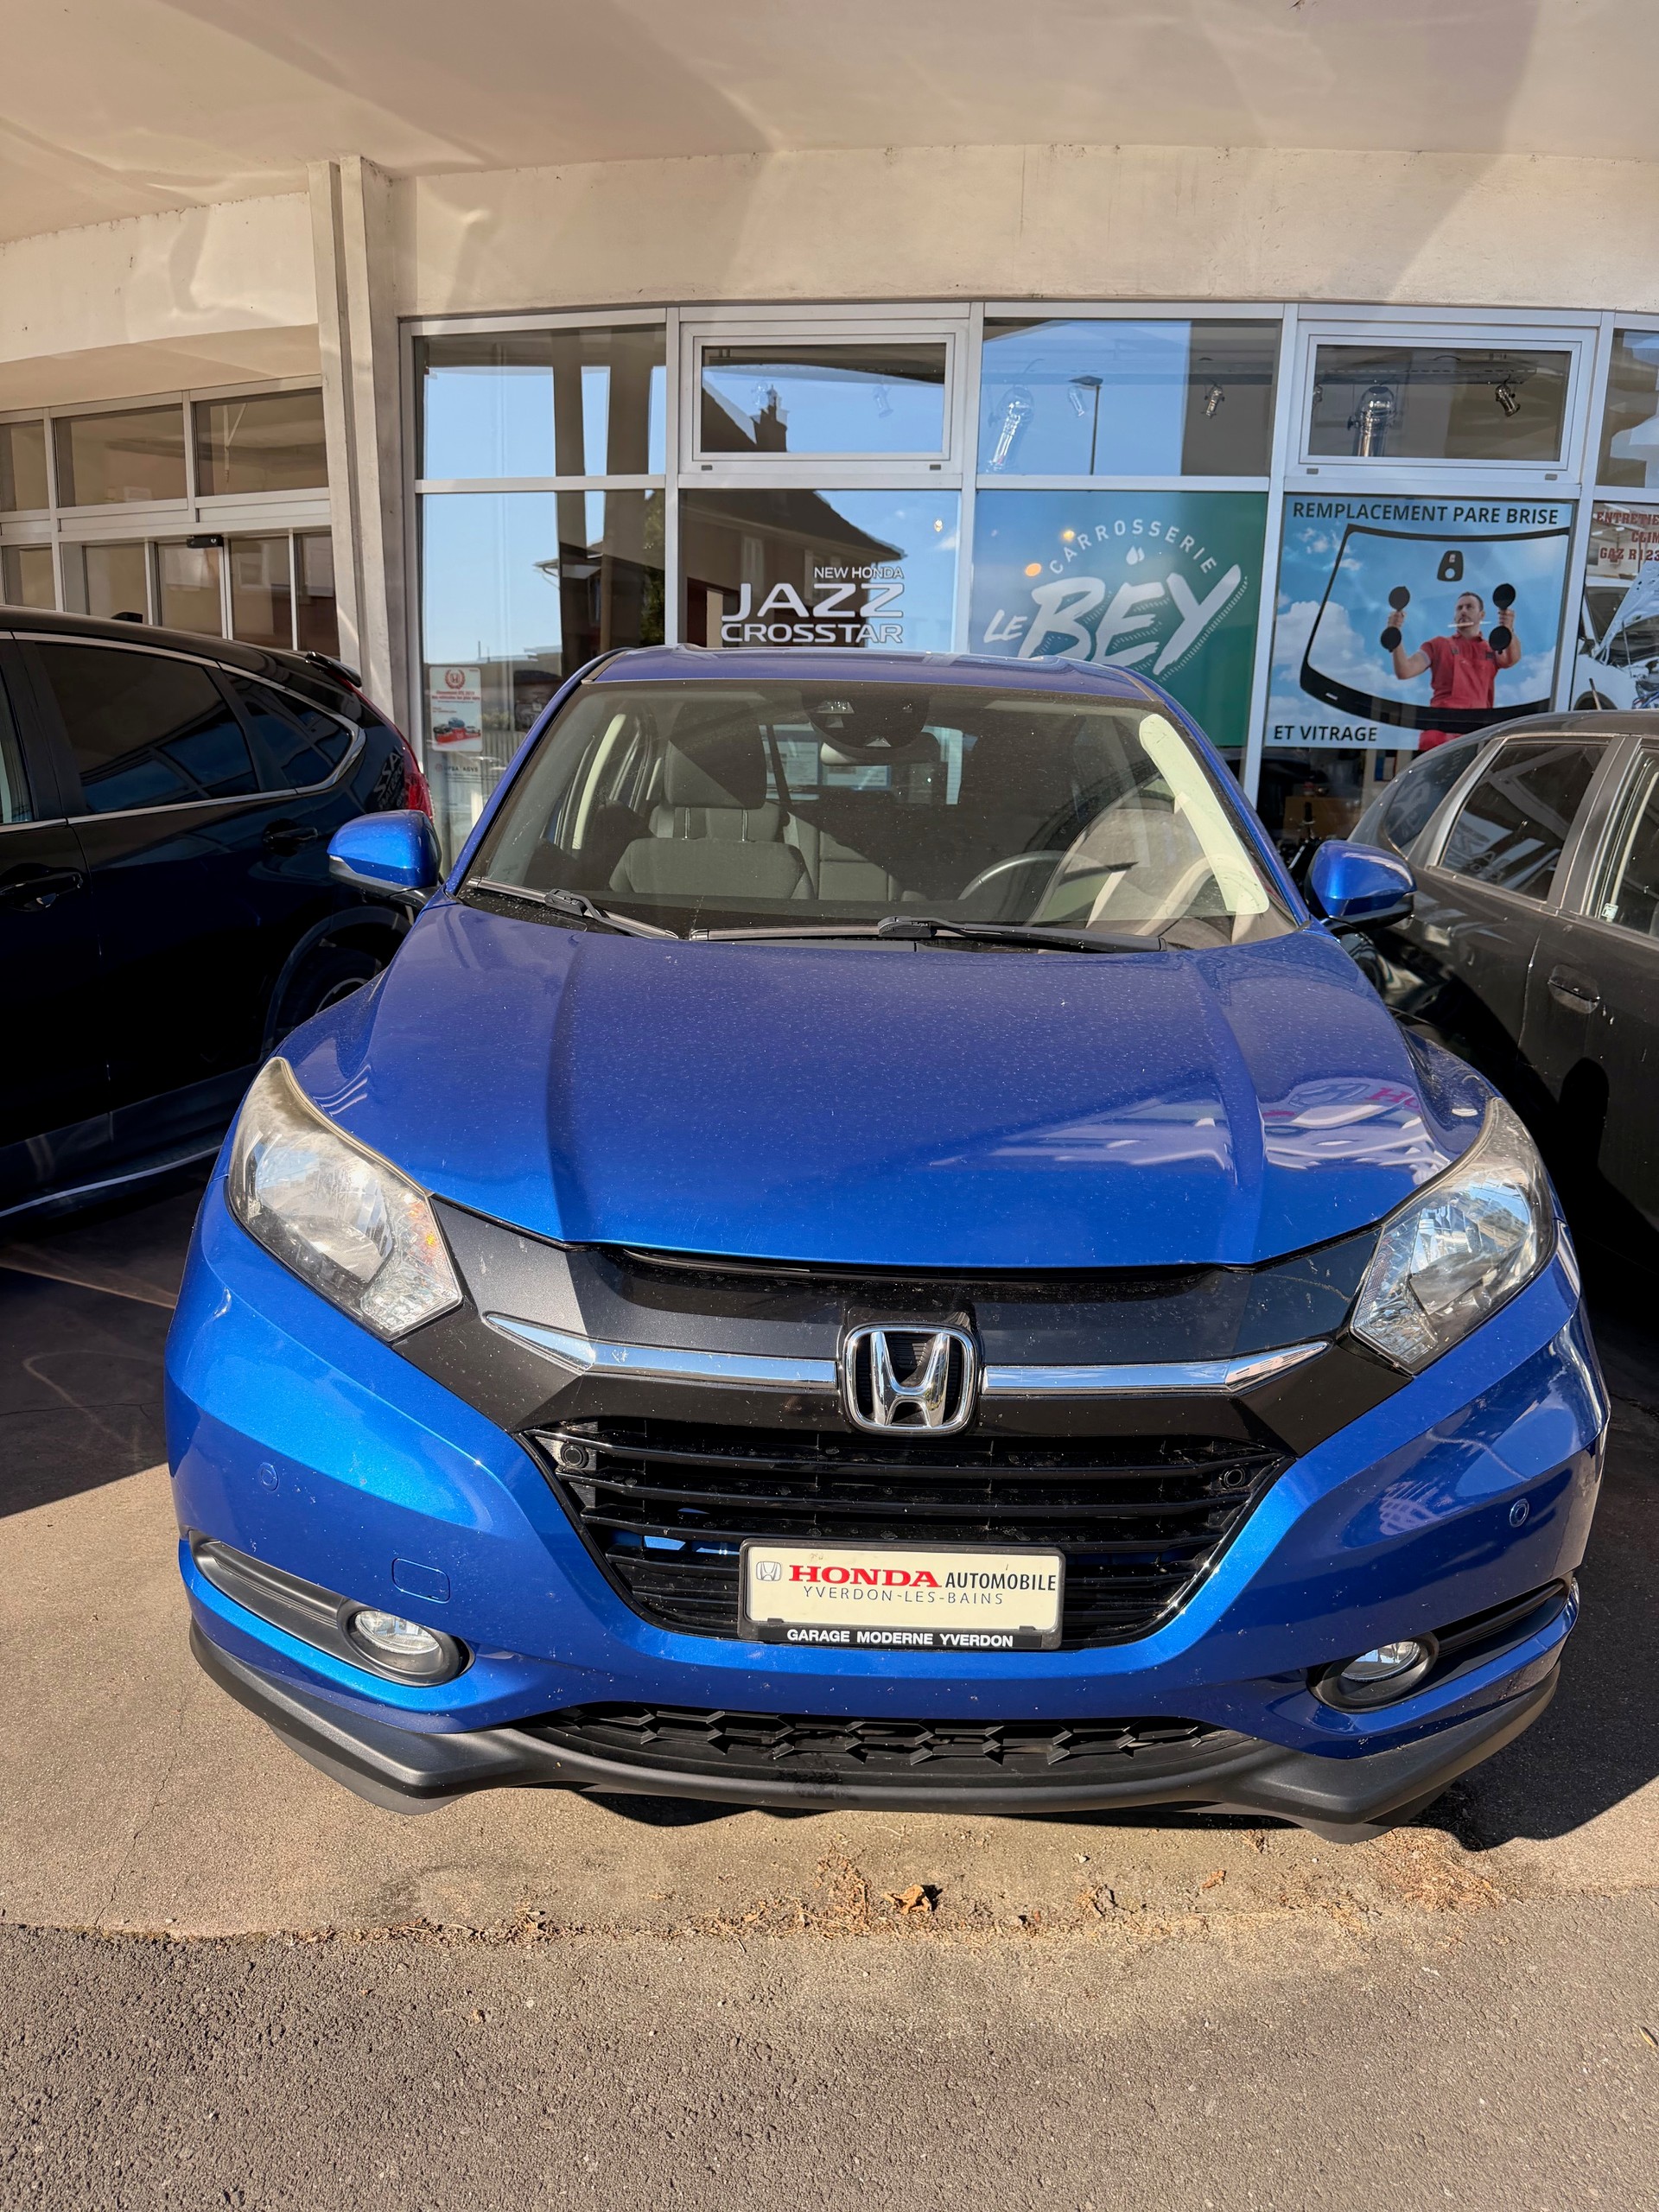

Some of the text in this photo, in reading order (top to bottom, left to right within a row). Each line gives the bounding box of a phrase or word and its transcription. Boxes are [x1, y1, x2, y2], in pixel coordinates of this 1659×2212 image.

[1293, 502, 1559, 524] REMPLACEMENT PARE BRISE
[1049, 518, 1217, 574] CARROSSERIE
[1599, 547, 1624, 560] GAZ
[813, 567, 905, 579] NEW HONDA
[721, 582, 905, 622] JAZZ
[983, 564, 1242, 676] LE BEY
[721, 623, 904, 644] CROSSTAR
[1274, 725, 1377, 742] ET VITRAGE
[789, 1564, 1057, 1592] HONDA AUTOMOBILE
[804, 1586, 1003, 1605] YVERDON-LES-BAINS
[786, 1629, 1014, 1648] GARAGE MODERNE YVERDON
